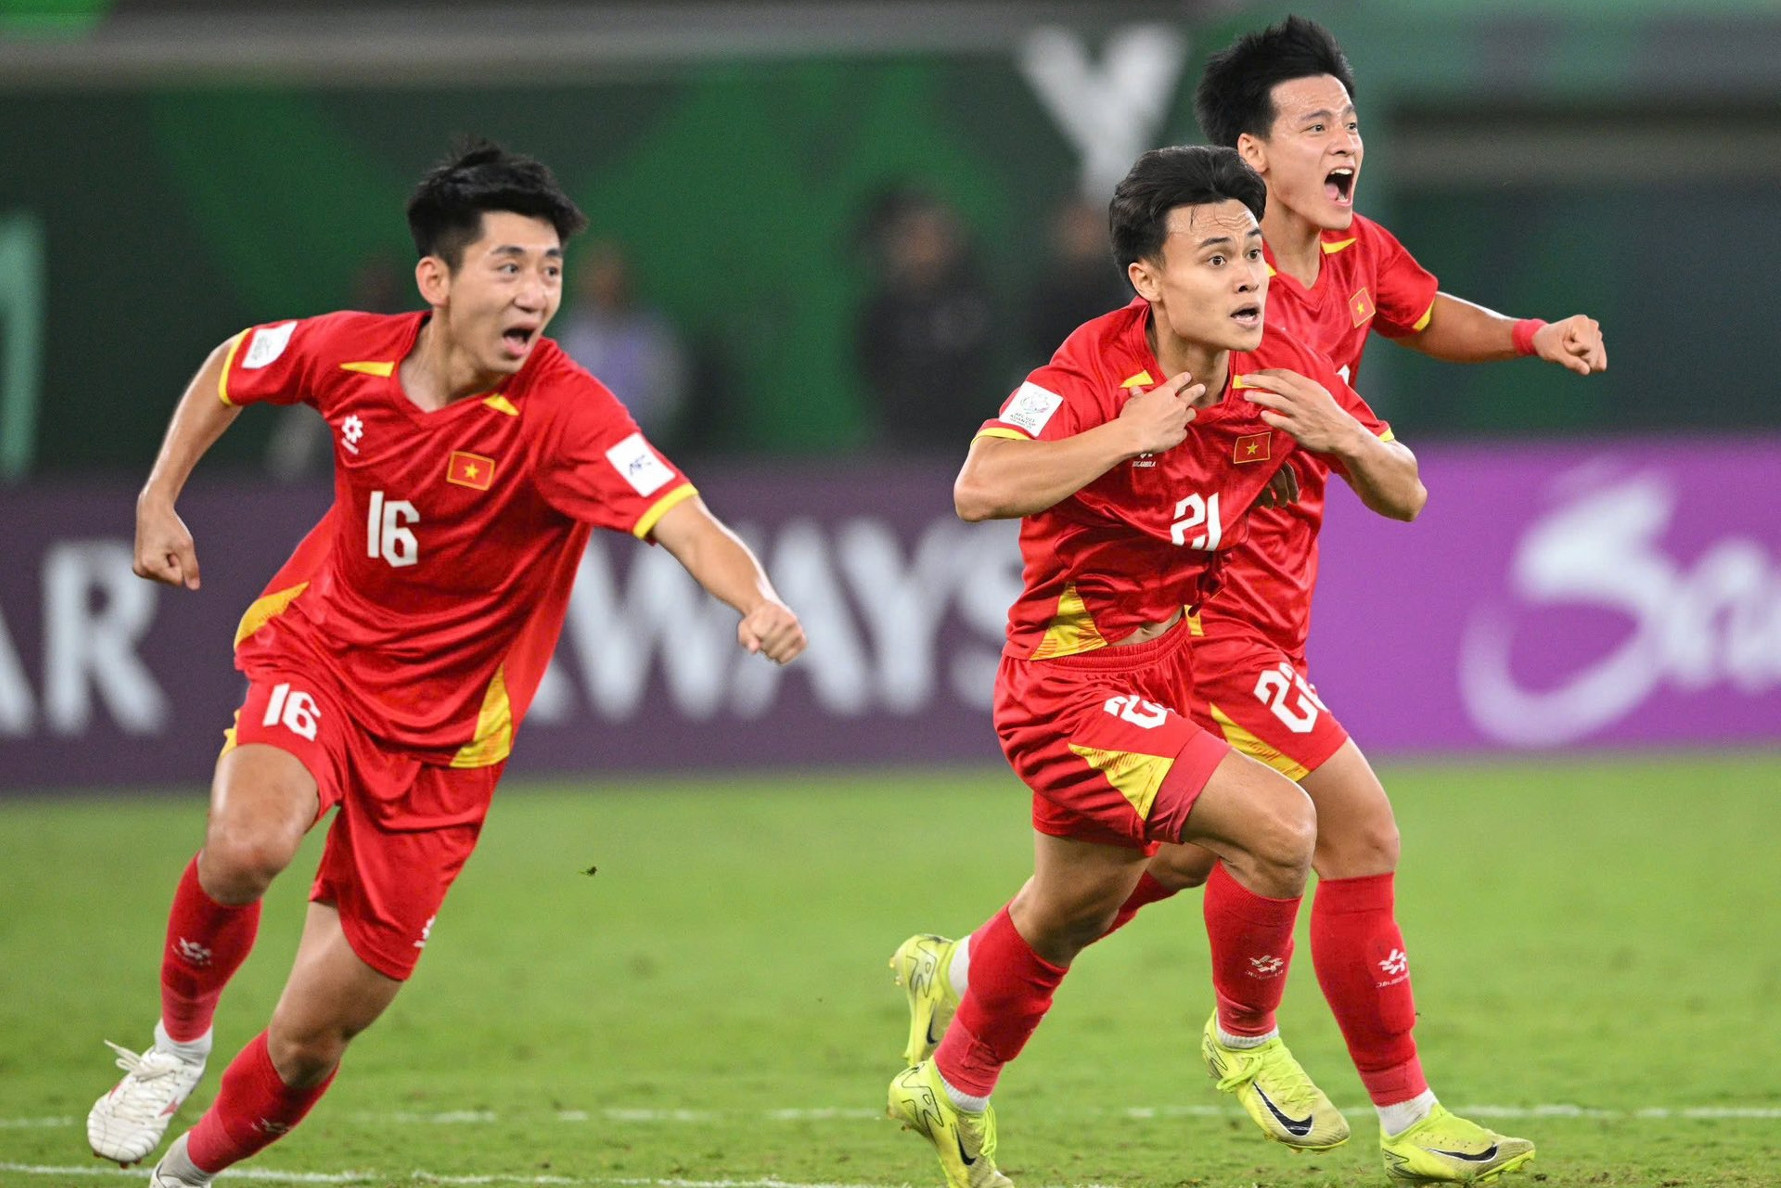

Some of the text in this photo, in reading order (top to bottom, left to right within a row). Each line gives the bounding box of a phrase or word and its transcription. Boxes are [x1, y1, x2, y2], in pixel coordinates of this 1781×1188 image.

[367, 491, 420, 567] 16
[1170, 491, 1222, 551] 21
[0, 514, 1022, 740] R WAYS
[264, 684, 321, 741] 16
